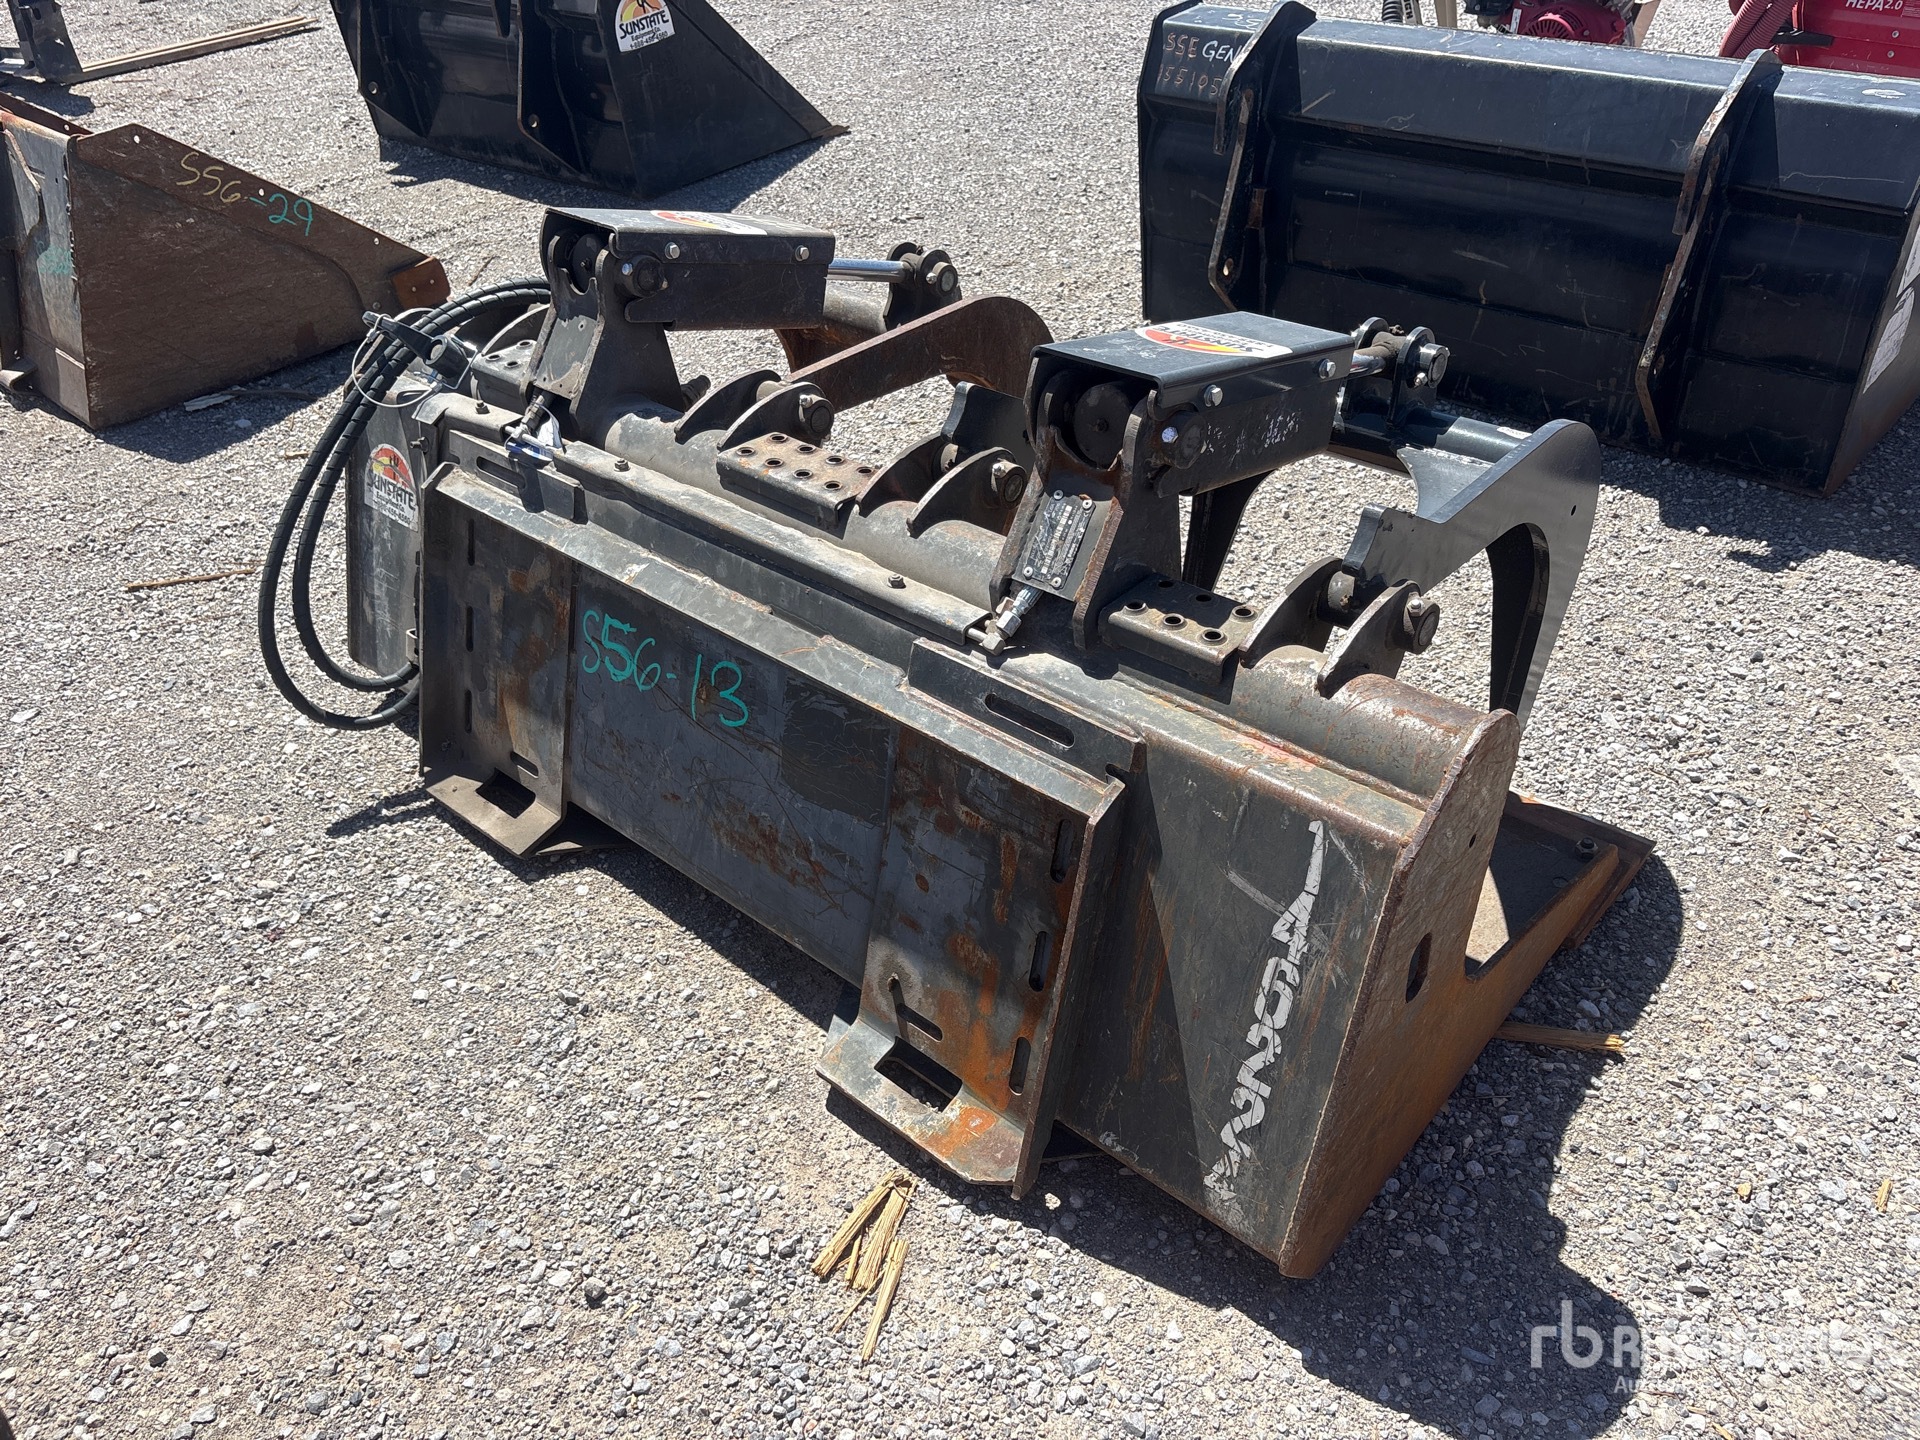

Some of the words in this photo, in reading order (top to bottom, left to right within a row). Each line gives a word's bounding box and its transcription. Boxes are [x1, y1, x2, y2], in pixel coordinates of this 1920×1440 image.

[1845, 0, 1884, 11] HEPA
[619, 10, 669, 39] SUNSTATE
[582, 610, 748, 727] S56-13
